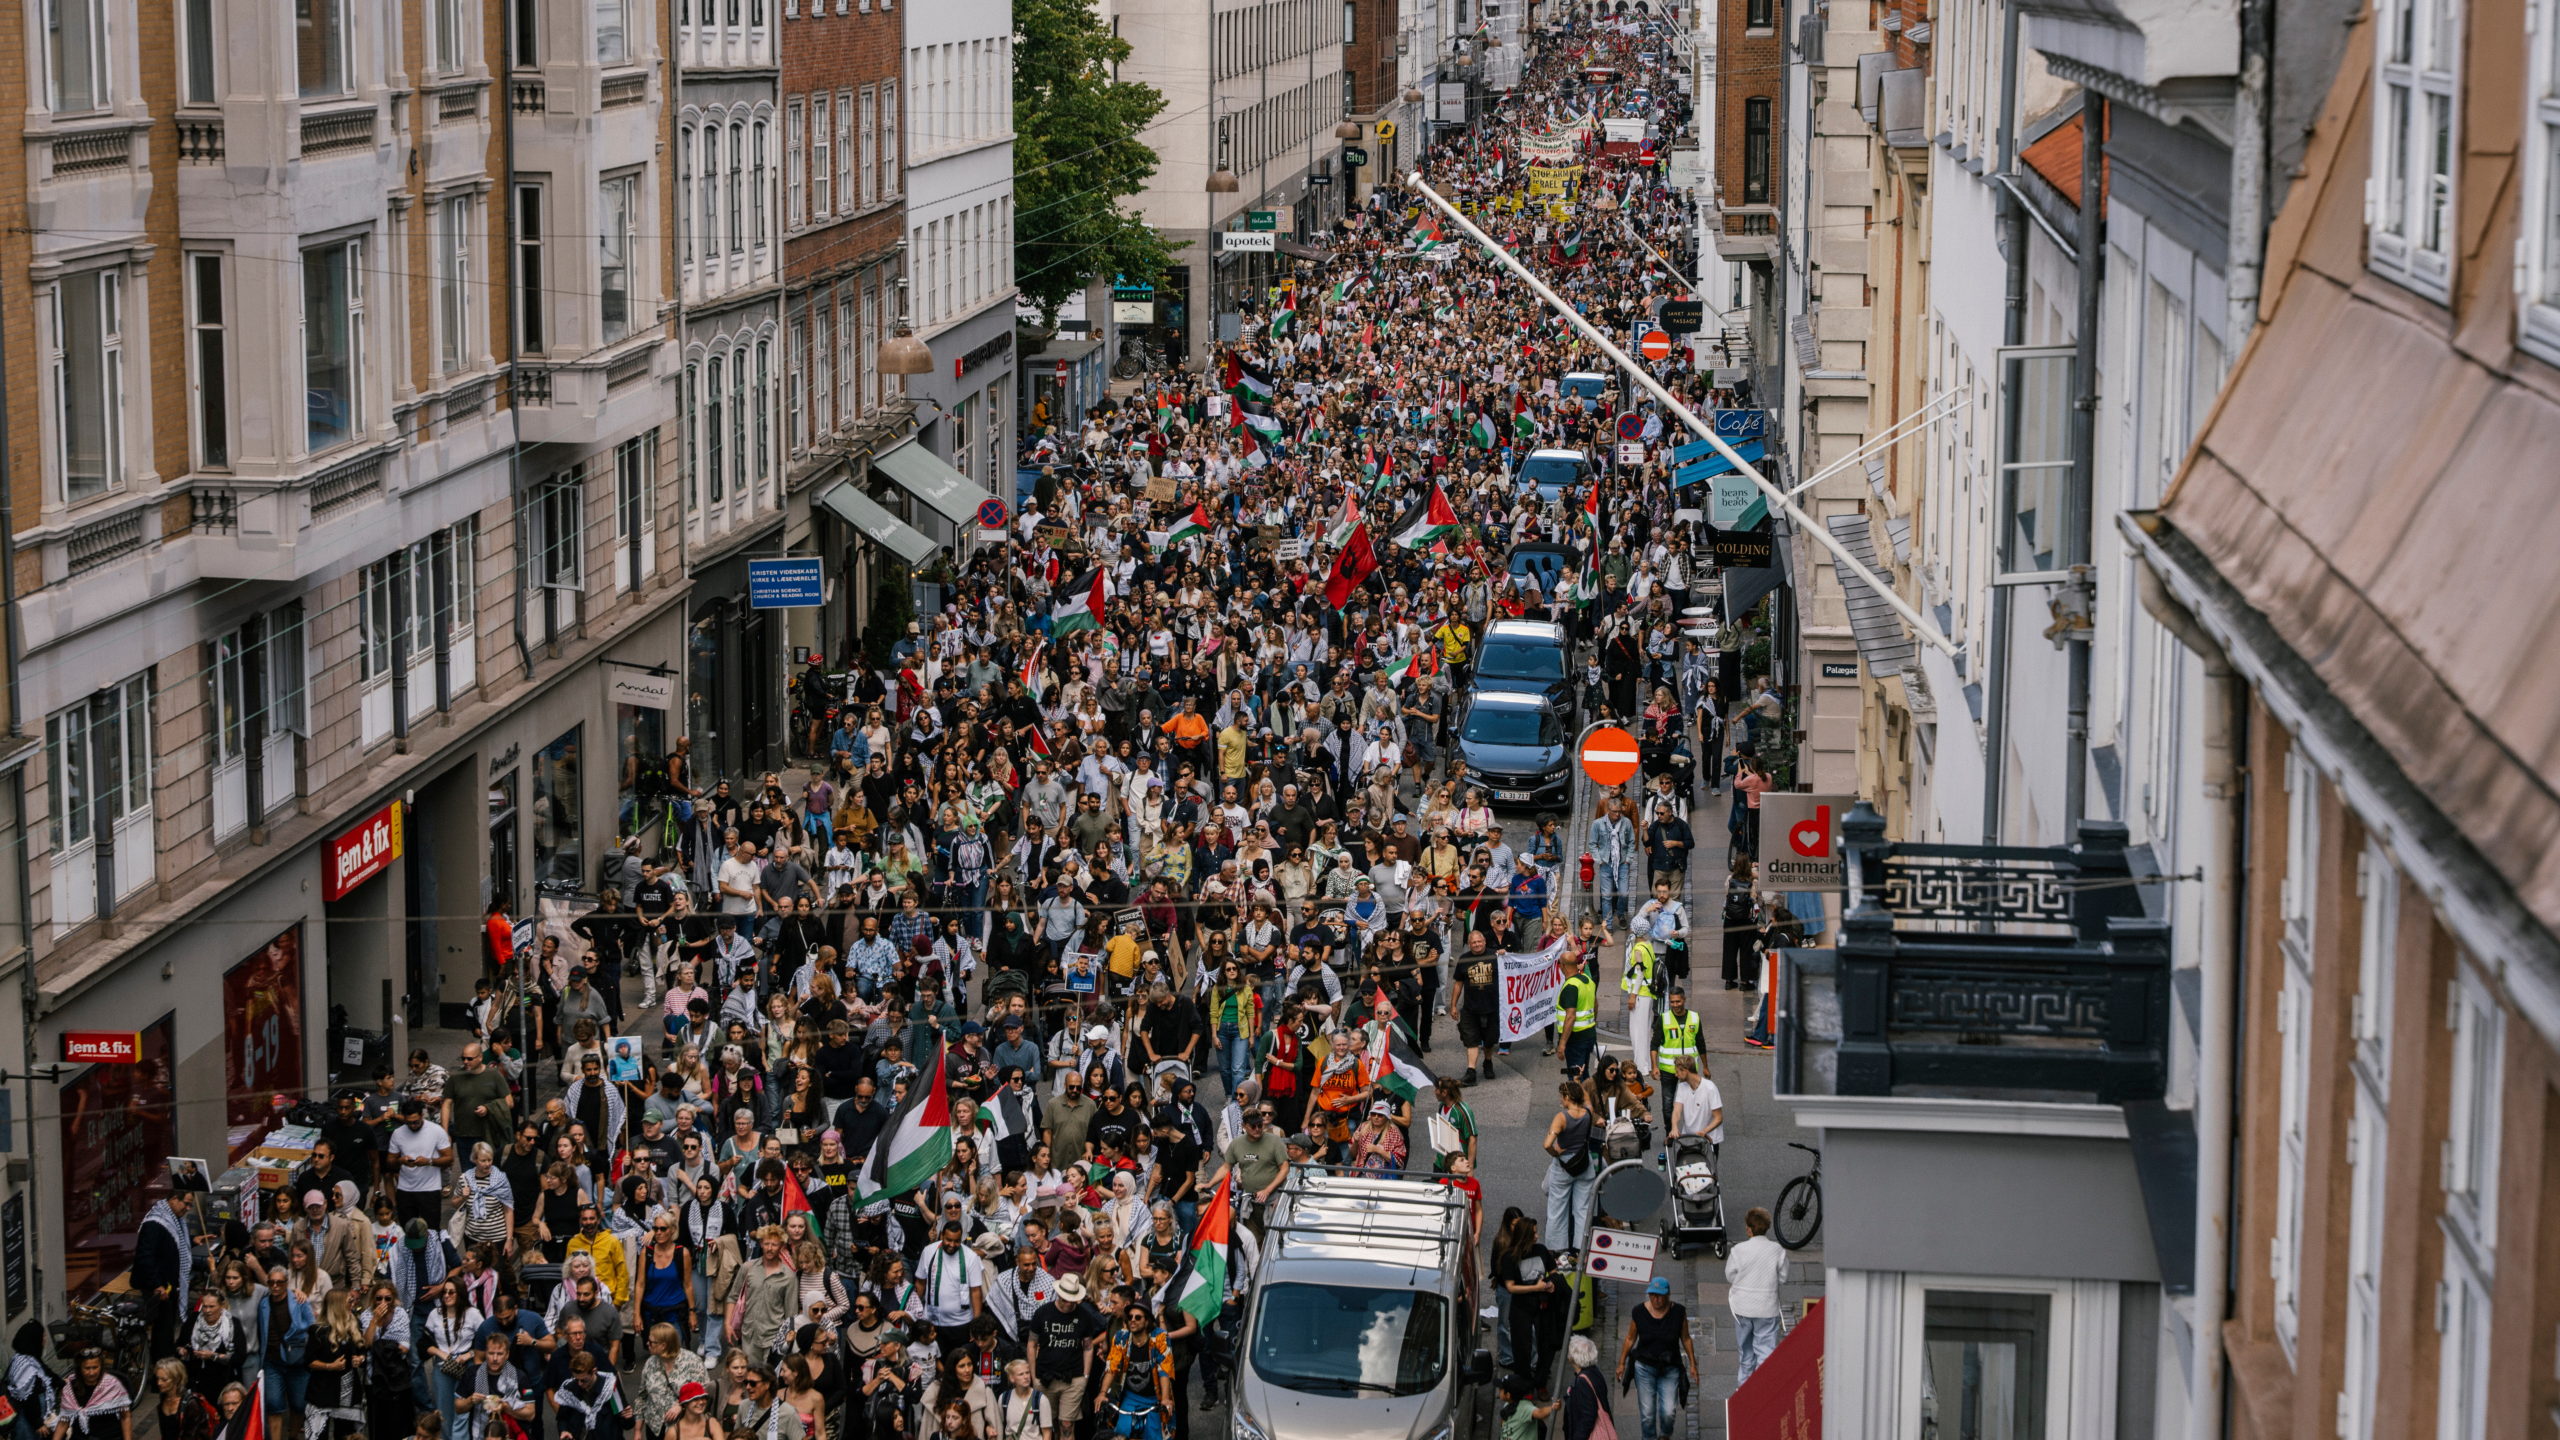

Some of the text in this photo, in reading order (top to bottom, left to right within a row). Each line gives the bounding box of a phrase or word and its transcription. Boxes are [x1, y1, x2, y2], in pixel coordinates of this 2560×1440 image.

[1532, 169, 1551, 178] STOP
[1225, 236, 1272, 248] apotek
[1717, 411, 1764, 436] Café
[1721, 488, 1748, 498] beans
[1721, 497, 1749, 508] beads
[1716, 542, 1770, 557] COLDING
[336, 843, 362, 890] jem
[362, 829, 374, 864] &
[373, 819, 390, 857] fix
[1768, 874, 1841, 884] SYGEFORSIKRIN
[68, 1040, 132, 1056] jem & fix
[243, 1013, 280, 1089] 8-19
[825, 1173, 847, 1187] AZA
